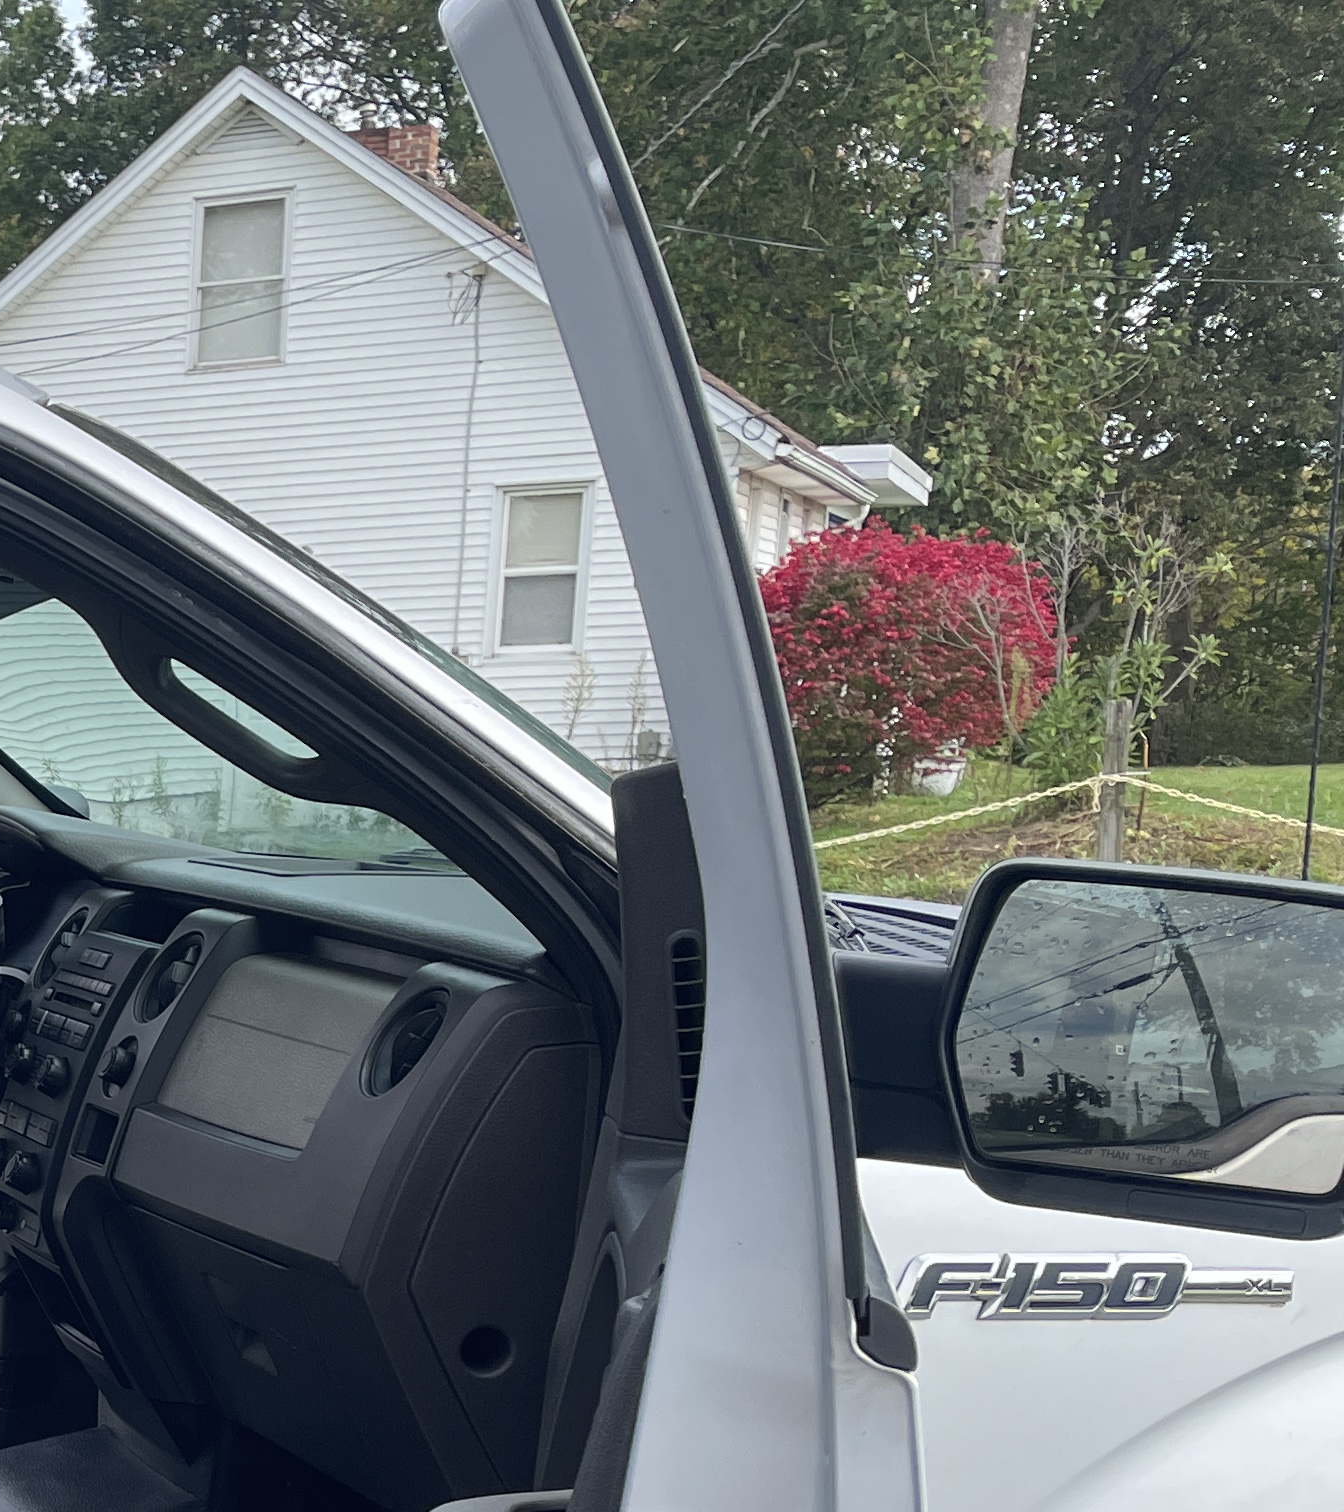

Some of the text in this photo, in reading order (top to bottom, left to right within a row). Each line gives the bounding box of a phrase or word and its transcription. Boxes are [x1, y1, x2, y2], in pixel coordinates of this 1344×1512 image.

[1101, 1148, 1131, 1161] THAN
[1135, 1153, 1165, 1166] THEY
[1187, 1148, 1212, 1159] ARE
[901, 1254, 1283, 1319] F-150 XL
